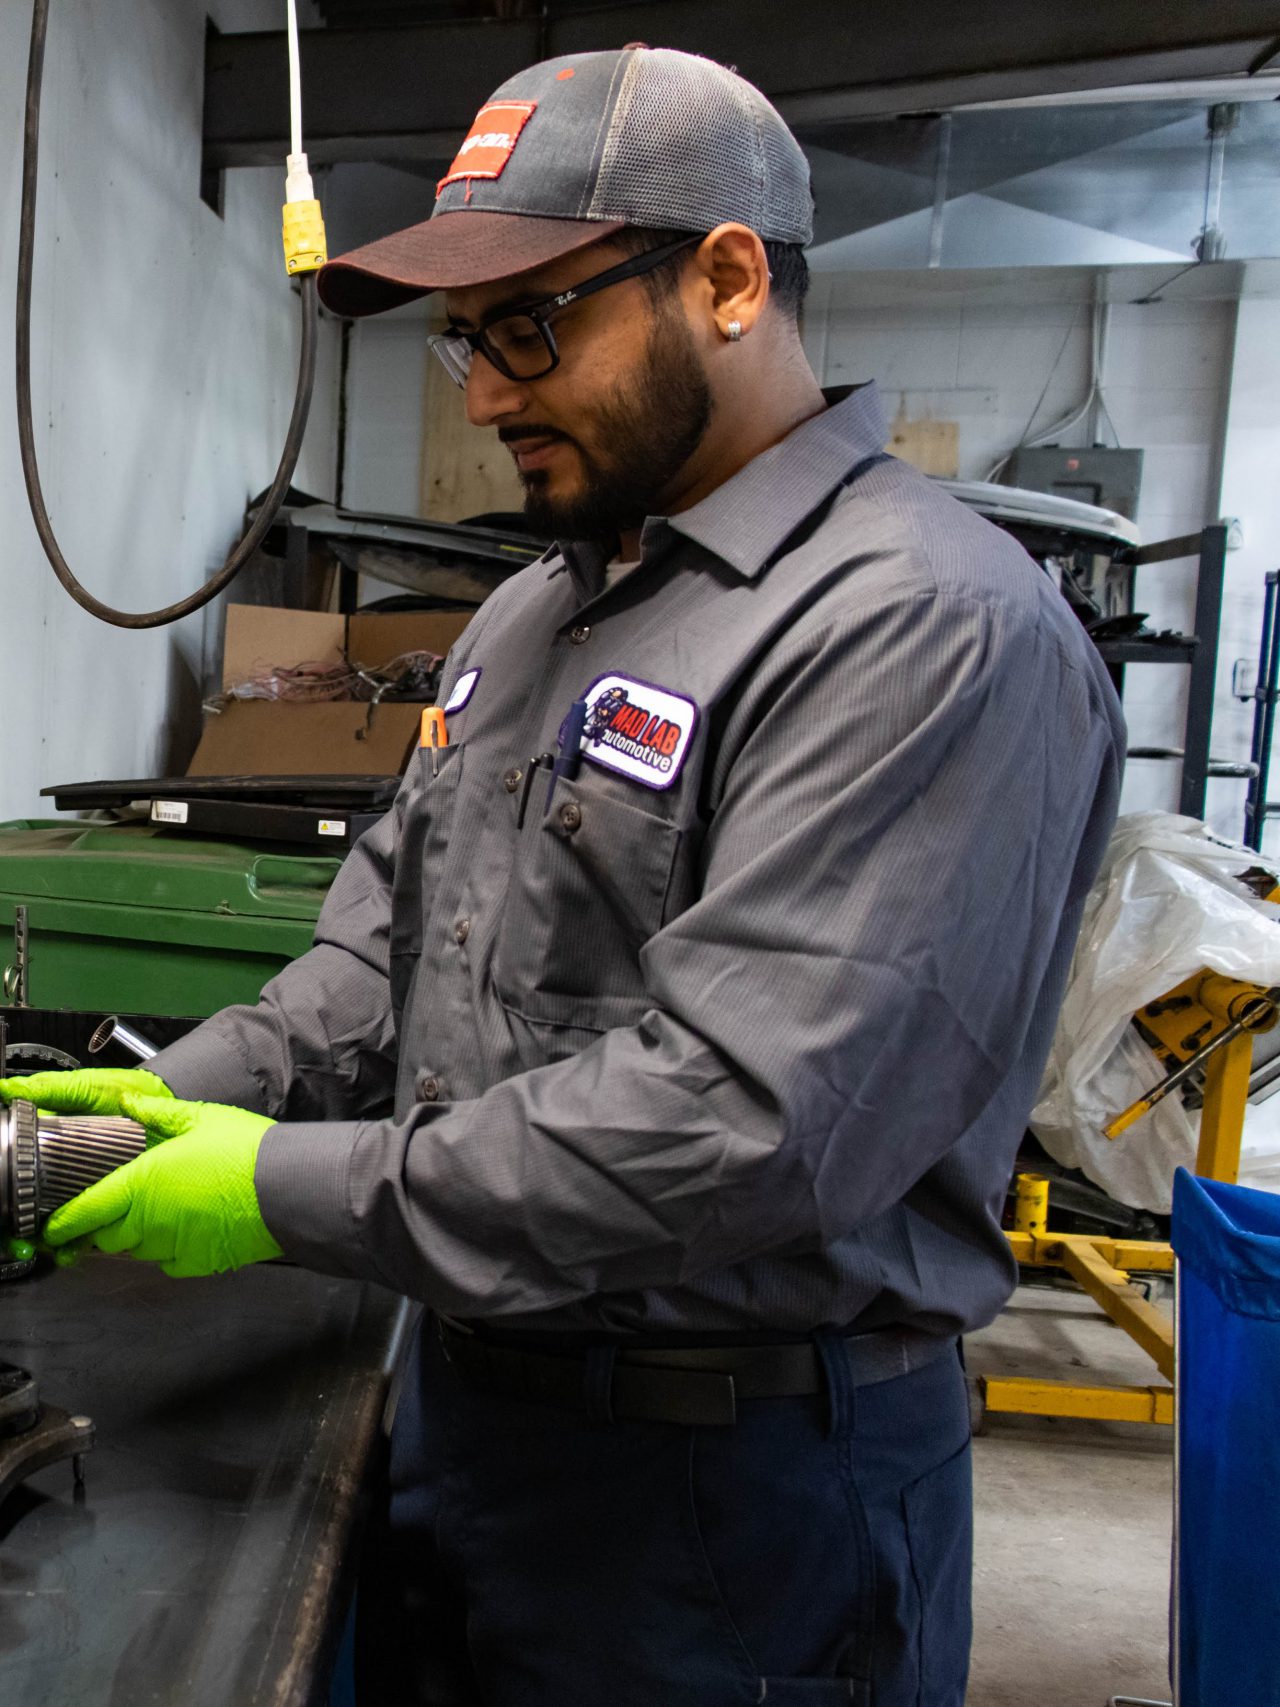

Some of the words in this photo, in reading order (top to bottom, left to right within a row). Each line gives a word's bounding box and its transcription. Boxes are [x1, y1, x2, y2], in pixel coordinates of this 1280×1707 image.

[601, 728, 672, 772] automotive
[609, 703, 650, 738] MAD
[641, 716, 681, 756] LAB
